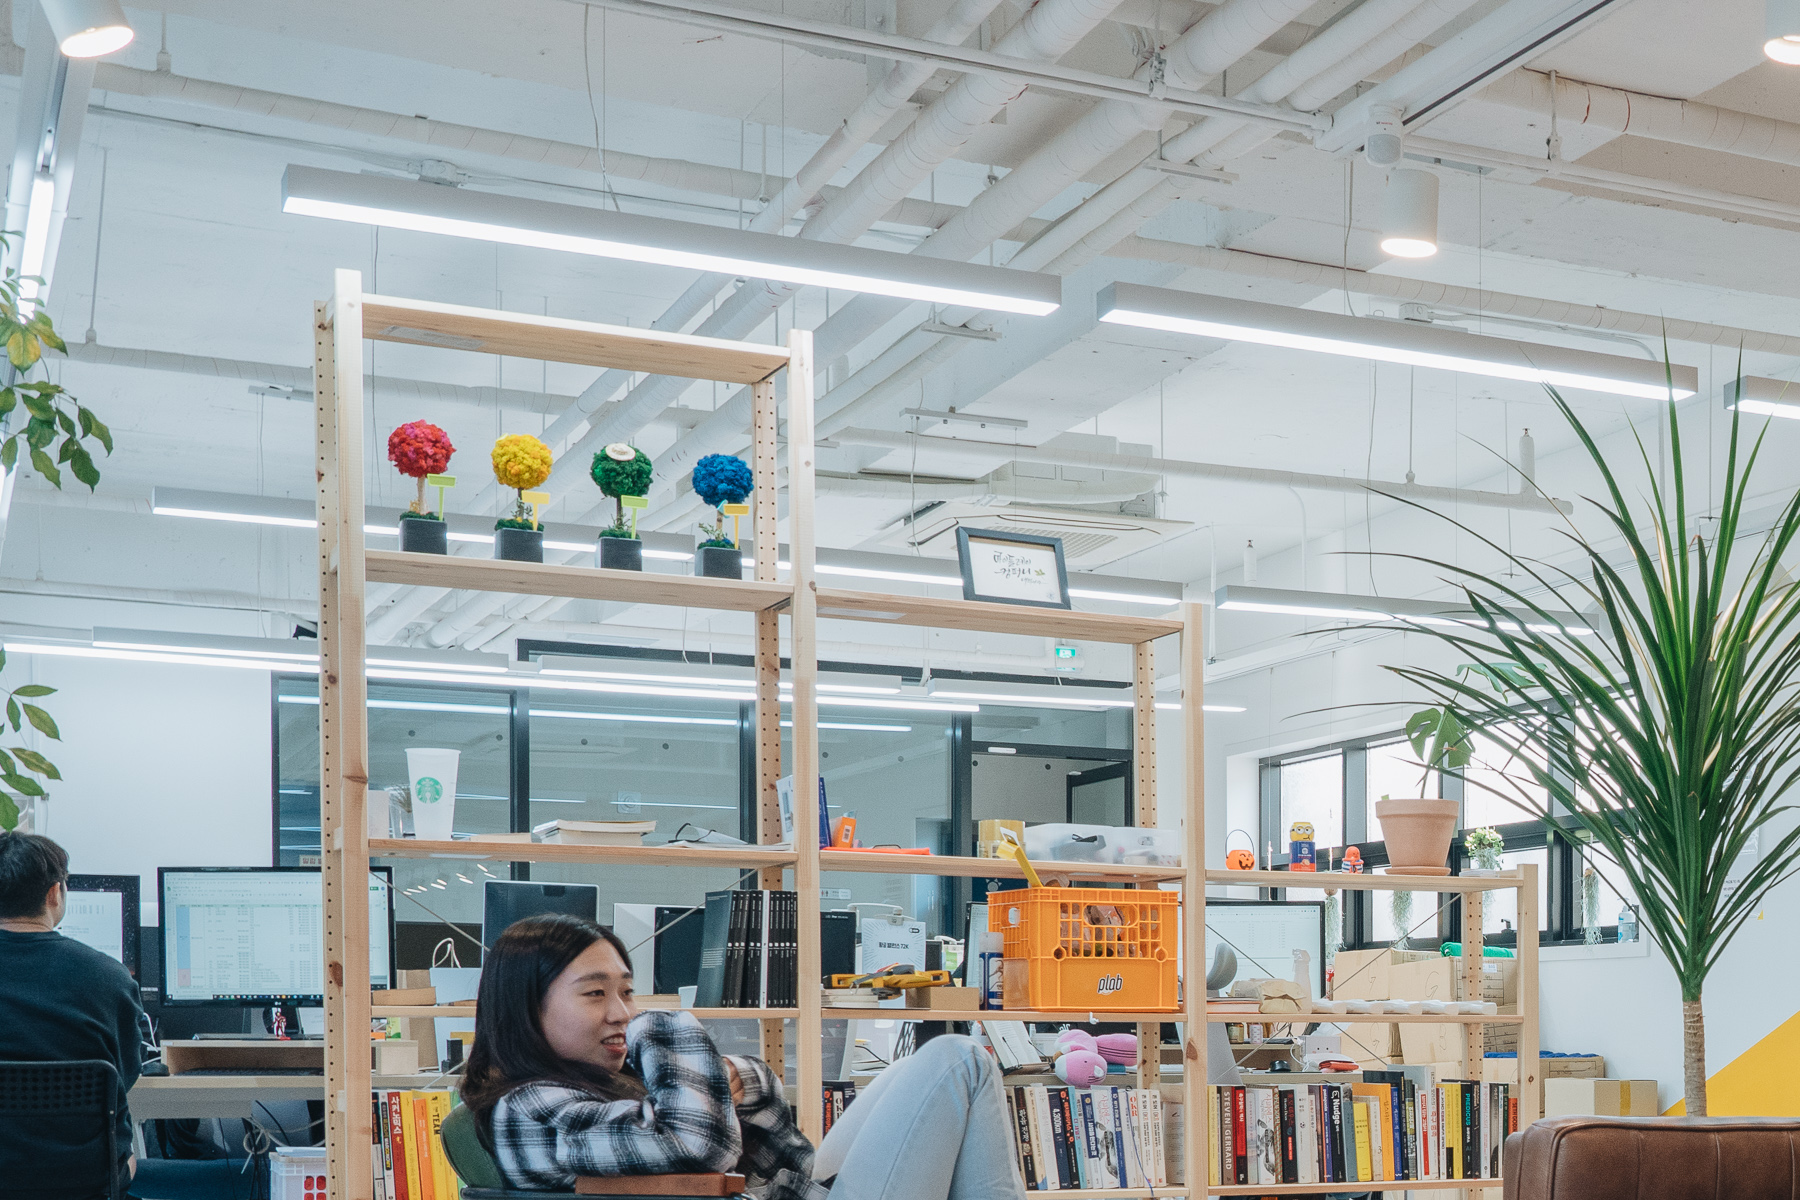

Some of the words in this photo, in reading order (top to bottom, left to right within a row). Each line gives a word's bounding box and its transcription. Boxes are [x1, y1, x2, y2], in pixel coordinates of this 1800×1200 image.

[1098, 973, 1123, 993] plab
[391, 1096, 402, 1135] 사커노믹스
[1129, 1096, 1138, 1117] OKR
[1332, 1099, 1341, 1125] Nudge
[432, 1114, 441, 1136] TEAM
